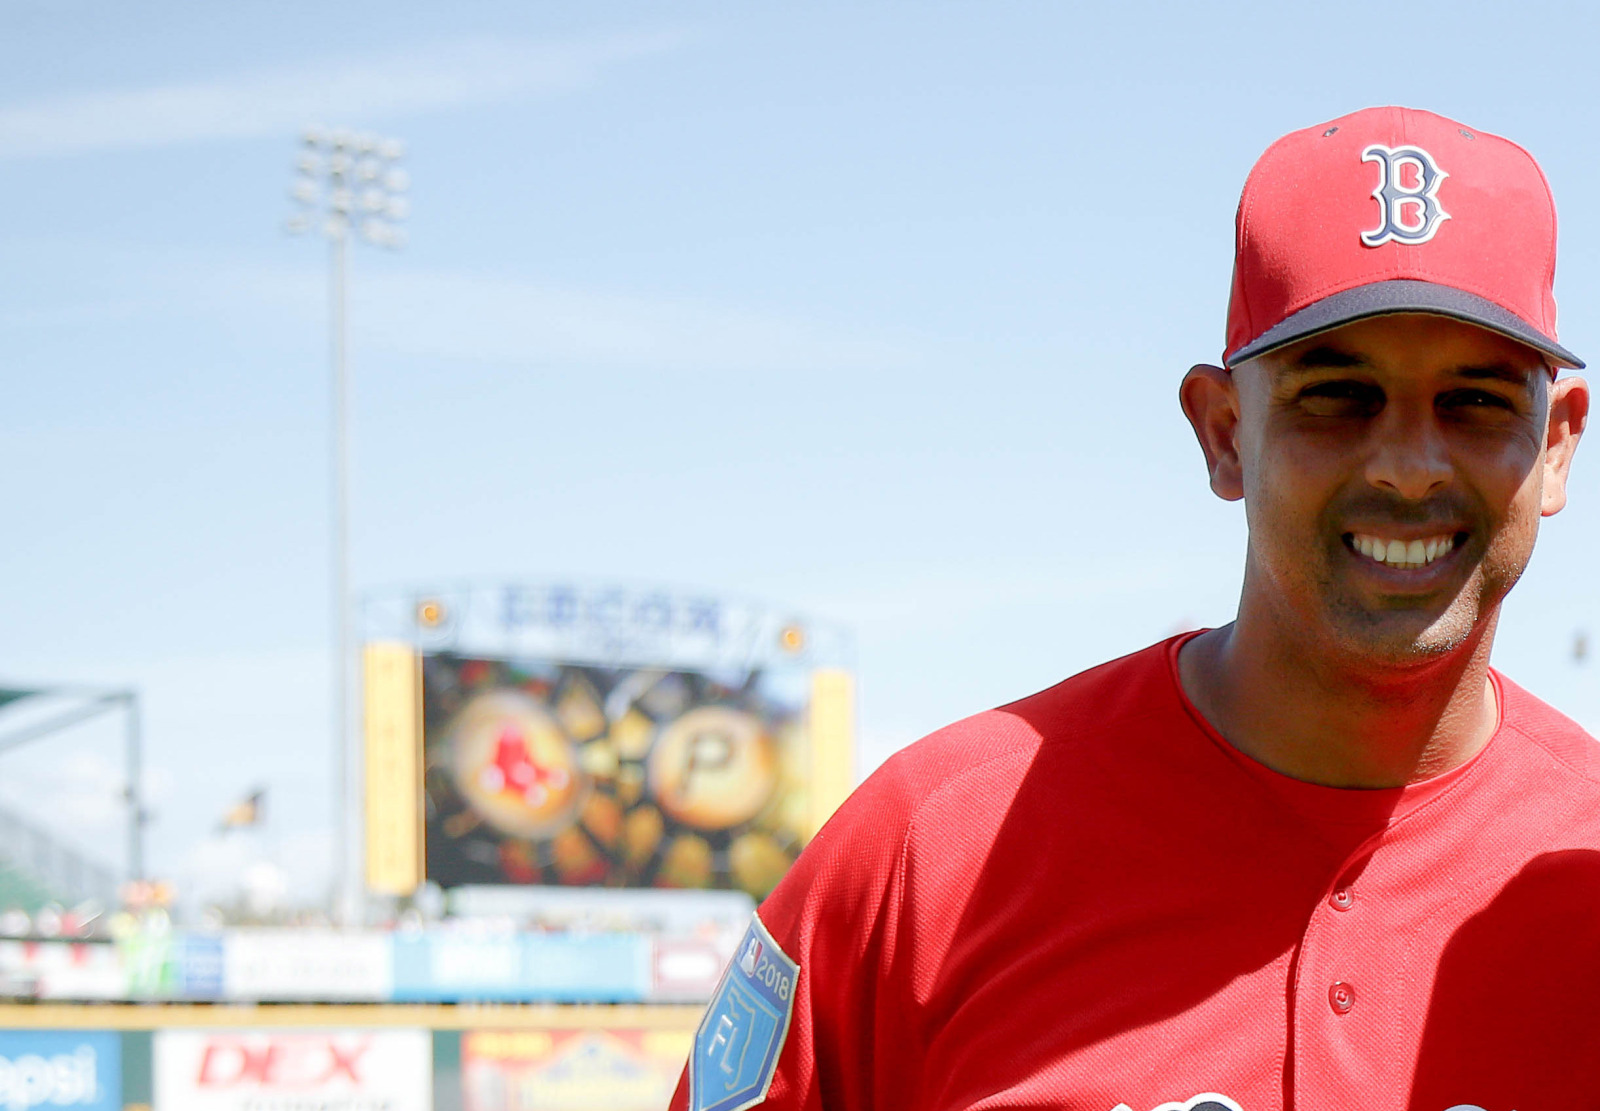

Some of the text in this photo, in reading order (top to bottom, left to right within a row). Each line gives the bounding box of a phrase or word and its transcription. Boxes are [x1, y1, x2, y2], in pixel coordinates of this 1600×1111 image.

[1360, 144, 1452, 247] B
[755, 956, 791, 1002] 2018
[708, 1013, 738, 1076] FL
